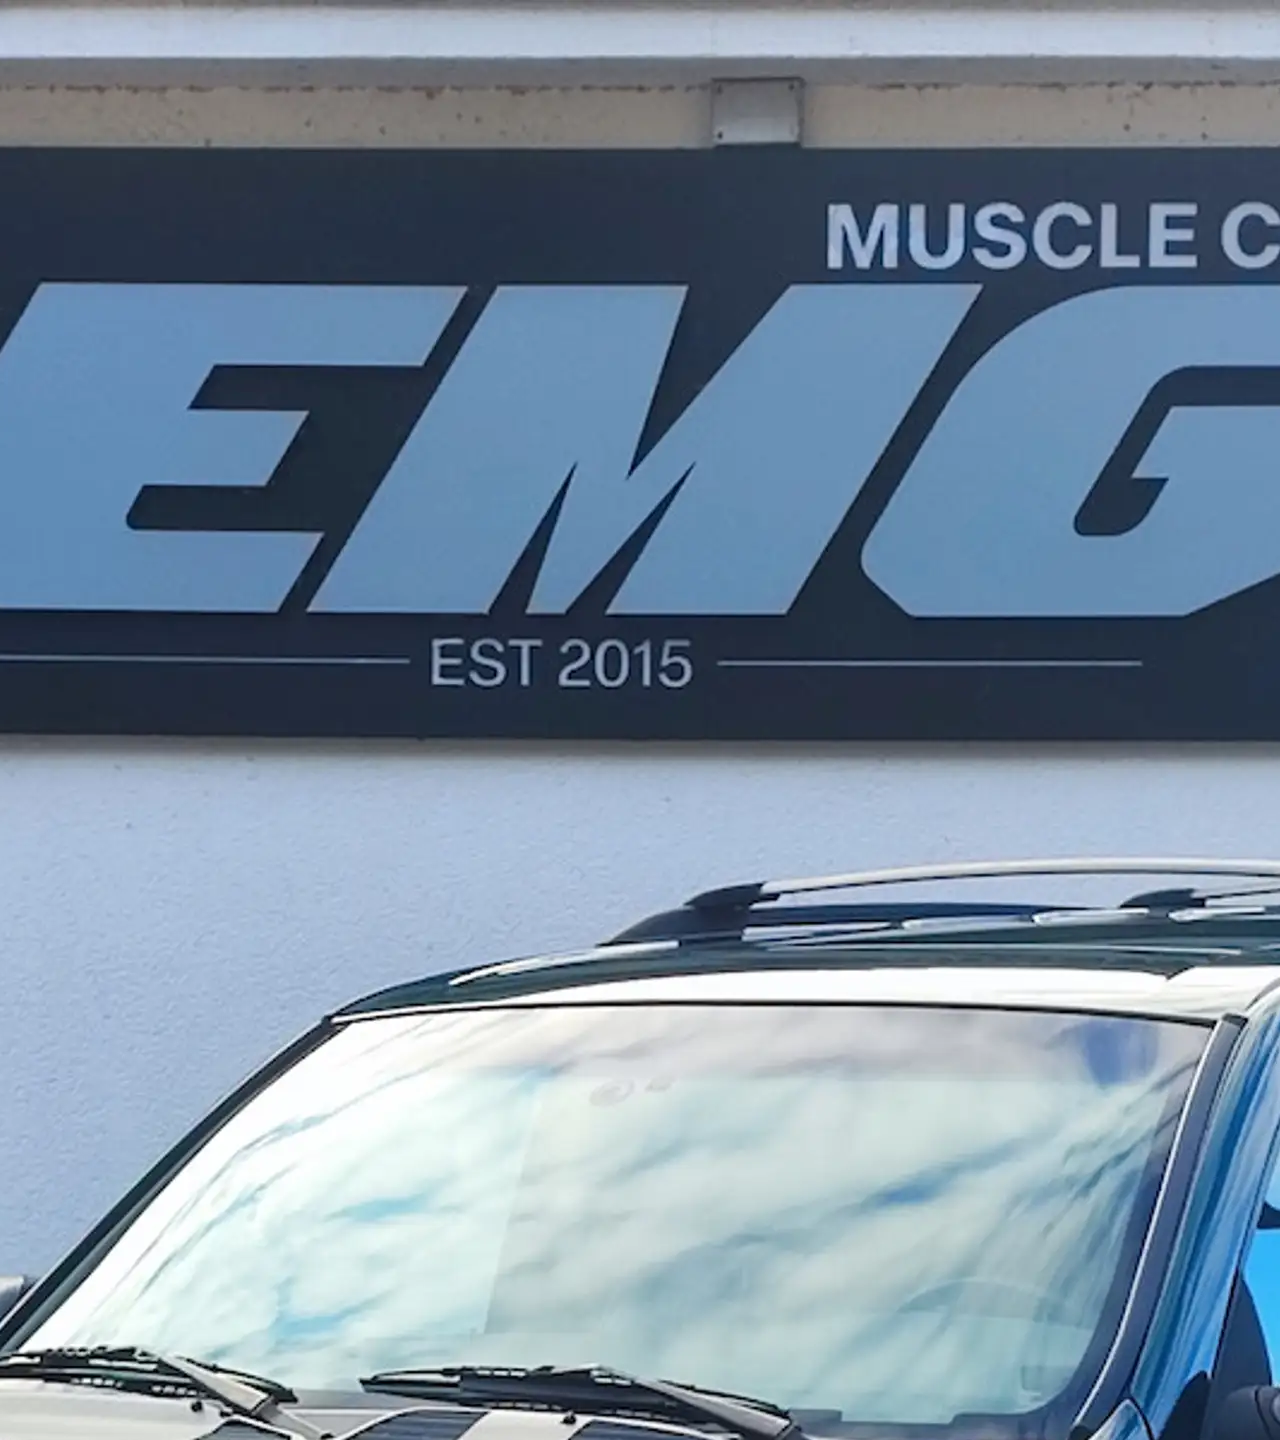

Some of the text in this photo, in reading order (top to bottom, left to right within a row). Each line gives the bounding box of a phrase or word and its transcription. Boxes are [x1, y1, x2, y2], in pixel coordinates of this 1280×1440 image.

[826, 201, 1198, 270] MUSCLE
[431, 637, 694, 688] EST 2015
